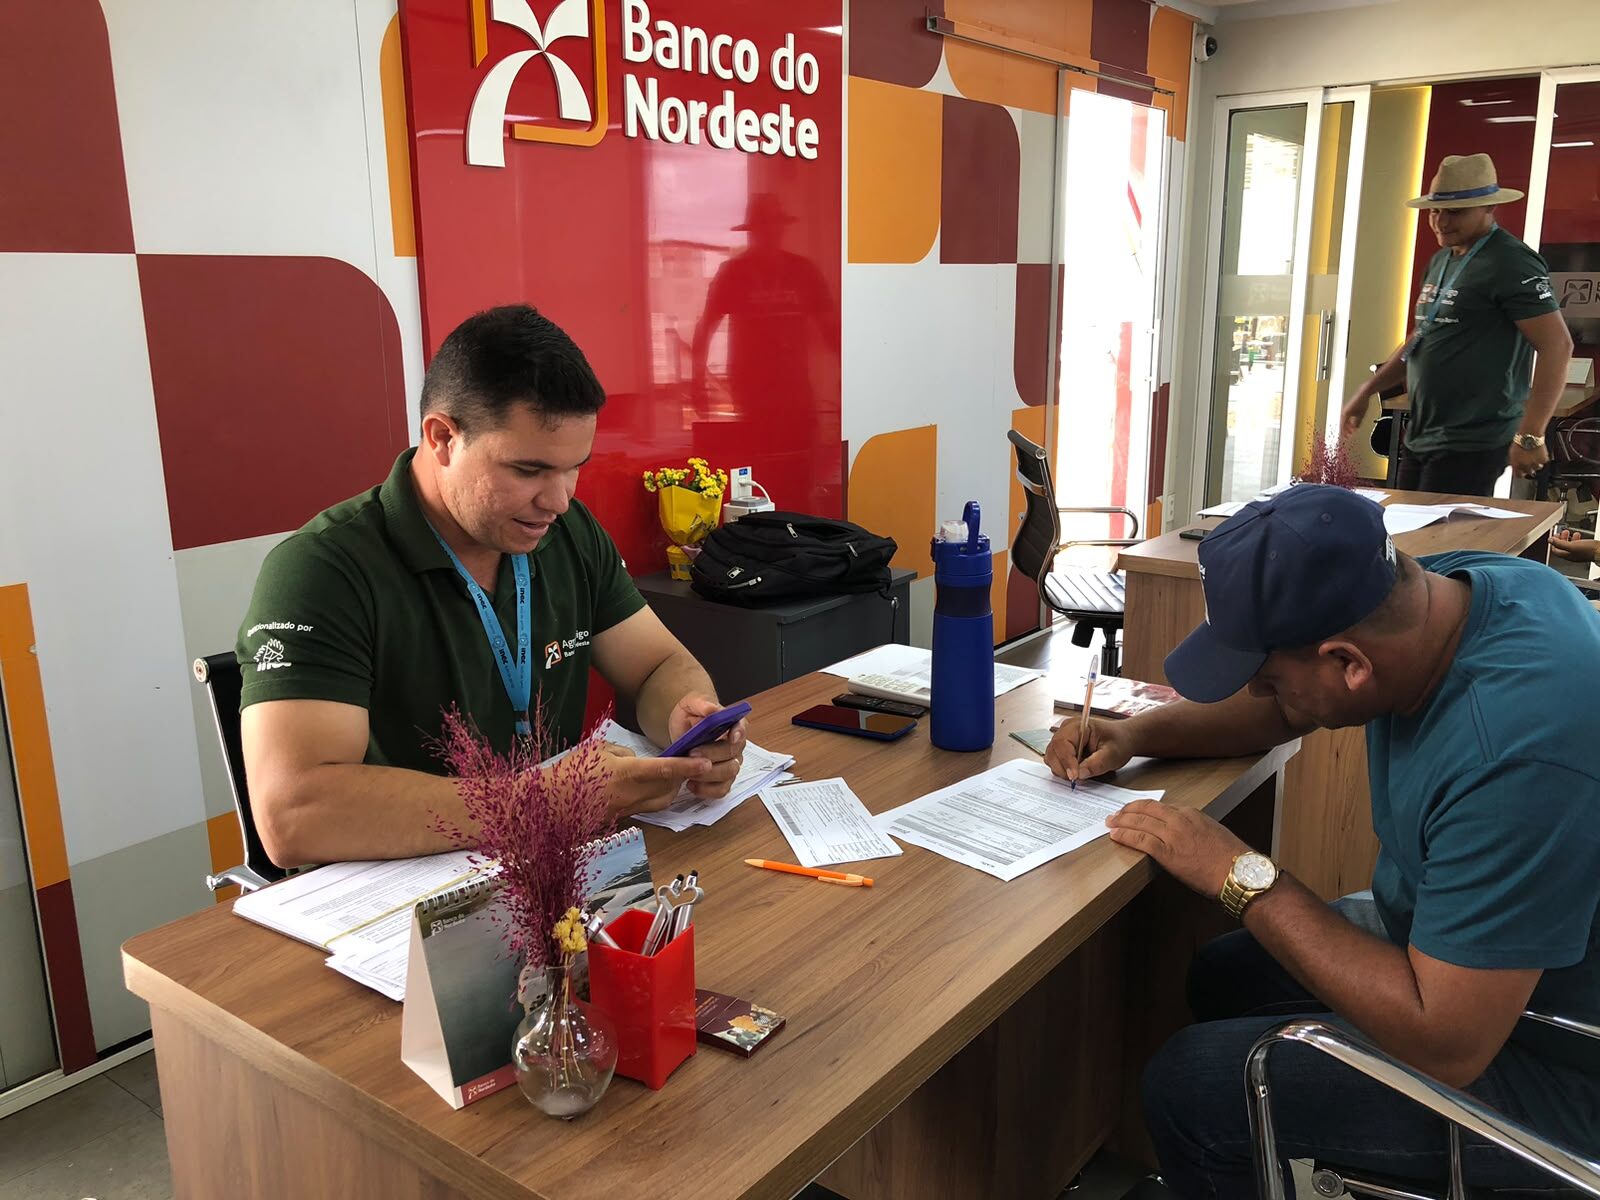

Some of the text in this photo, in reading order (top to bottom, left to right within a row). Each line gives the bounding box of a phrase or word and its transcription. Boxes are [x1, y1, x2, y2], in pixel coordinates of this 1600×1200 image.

[622, 0, 820, 95] Banco do
[624, 73, 820, 160] Nordeste
[297, 624, 314, 632] por
